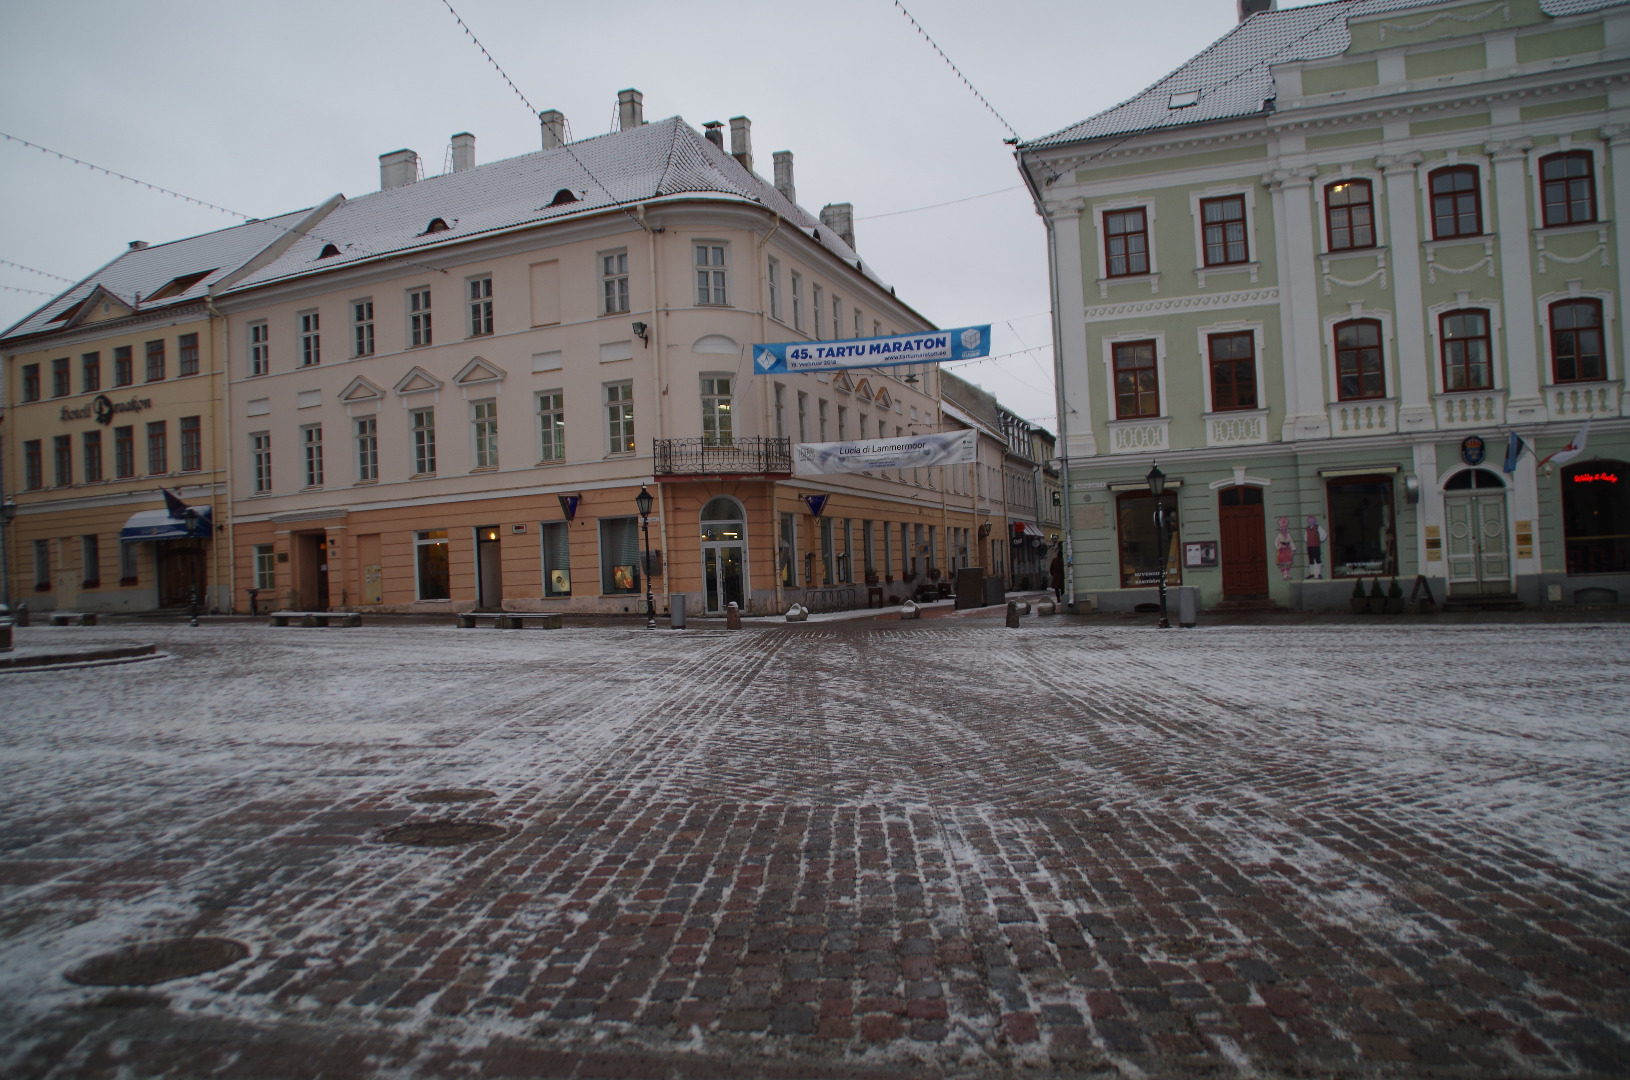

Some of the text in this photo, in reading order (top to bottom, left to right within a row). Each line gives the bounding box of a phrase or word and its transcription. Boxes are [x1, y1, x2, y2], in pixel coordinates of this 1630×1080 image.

[790, 349, 813, 360] 45.
[816, 344, 866, 359] TARTU
[869, 336, 947, 355] MARATON
[839, 442, 926, 455] Lucia di Lammermoor
